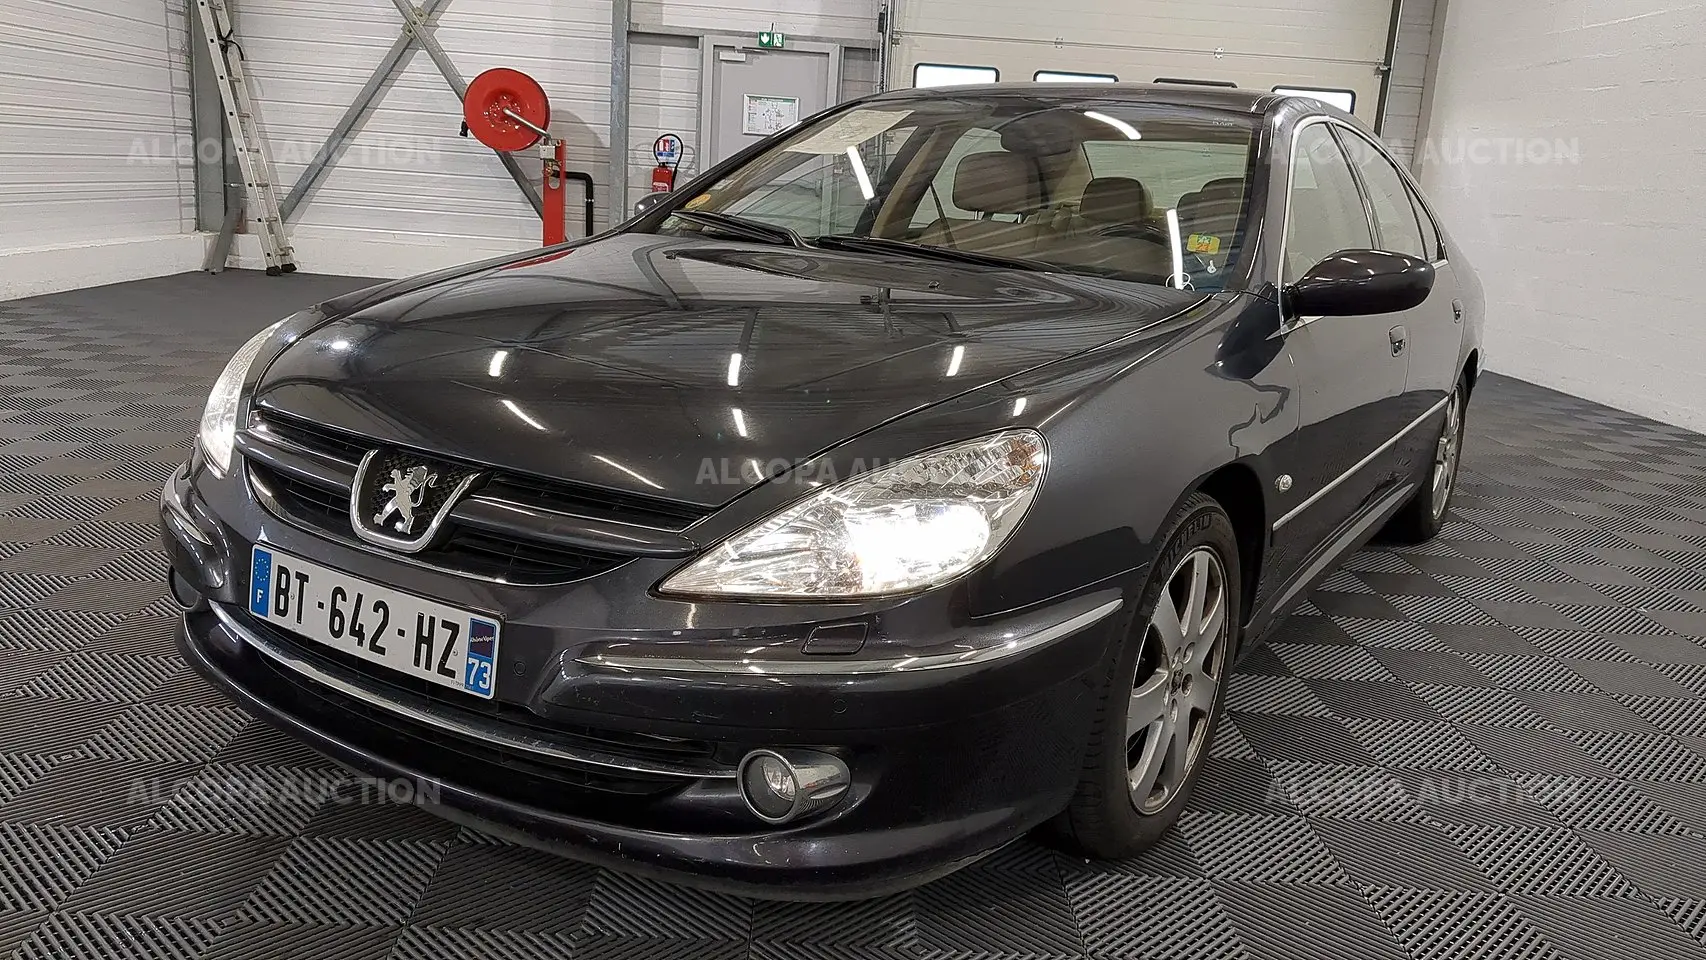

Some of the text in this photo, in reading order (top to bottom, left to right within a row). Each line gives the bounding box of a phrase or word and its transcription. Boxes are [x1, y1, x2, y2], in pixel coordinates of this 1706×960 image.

[256, 588, 264, 604] F
[274, 564, 460, 679] BT-642-HZ
[468, 657, 492, 689] 73
